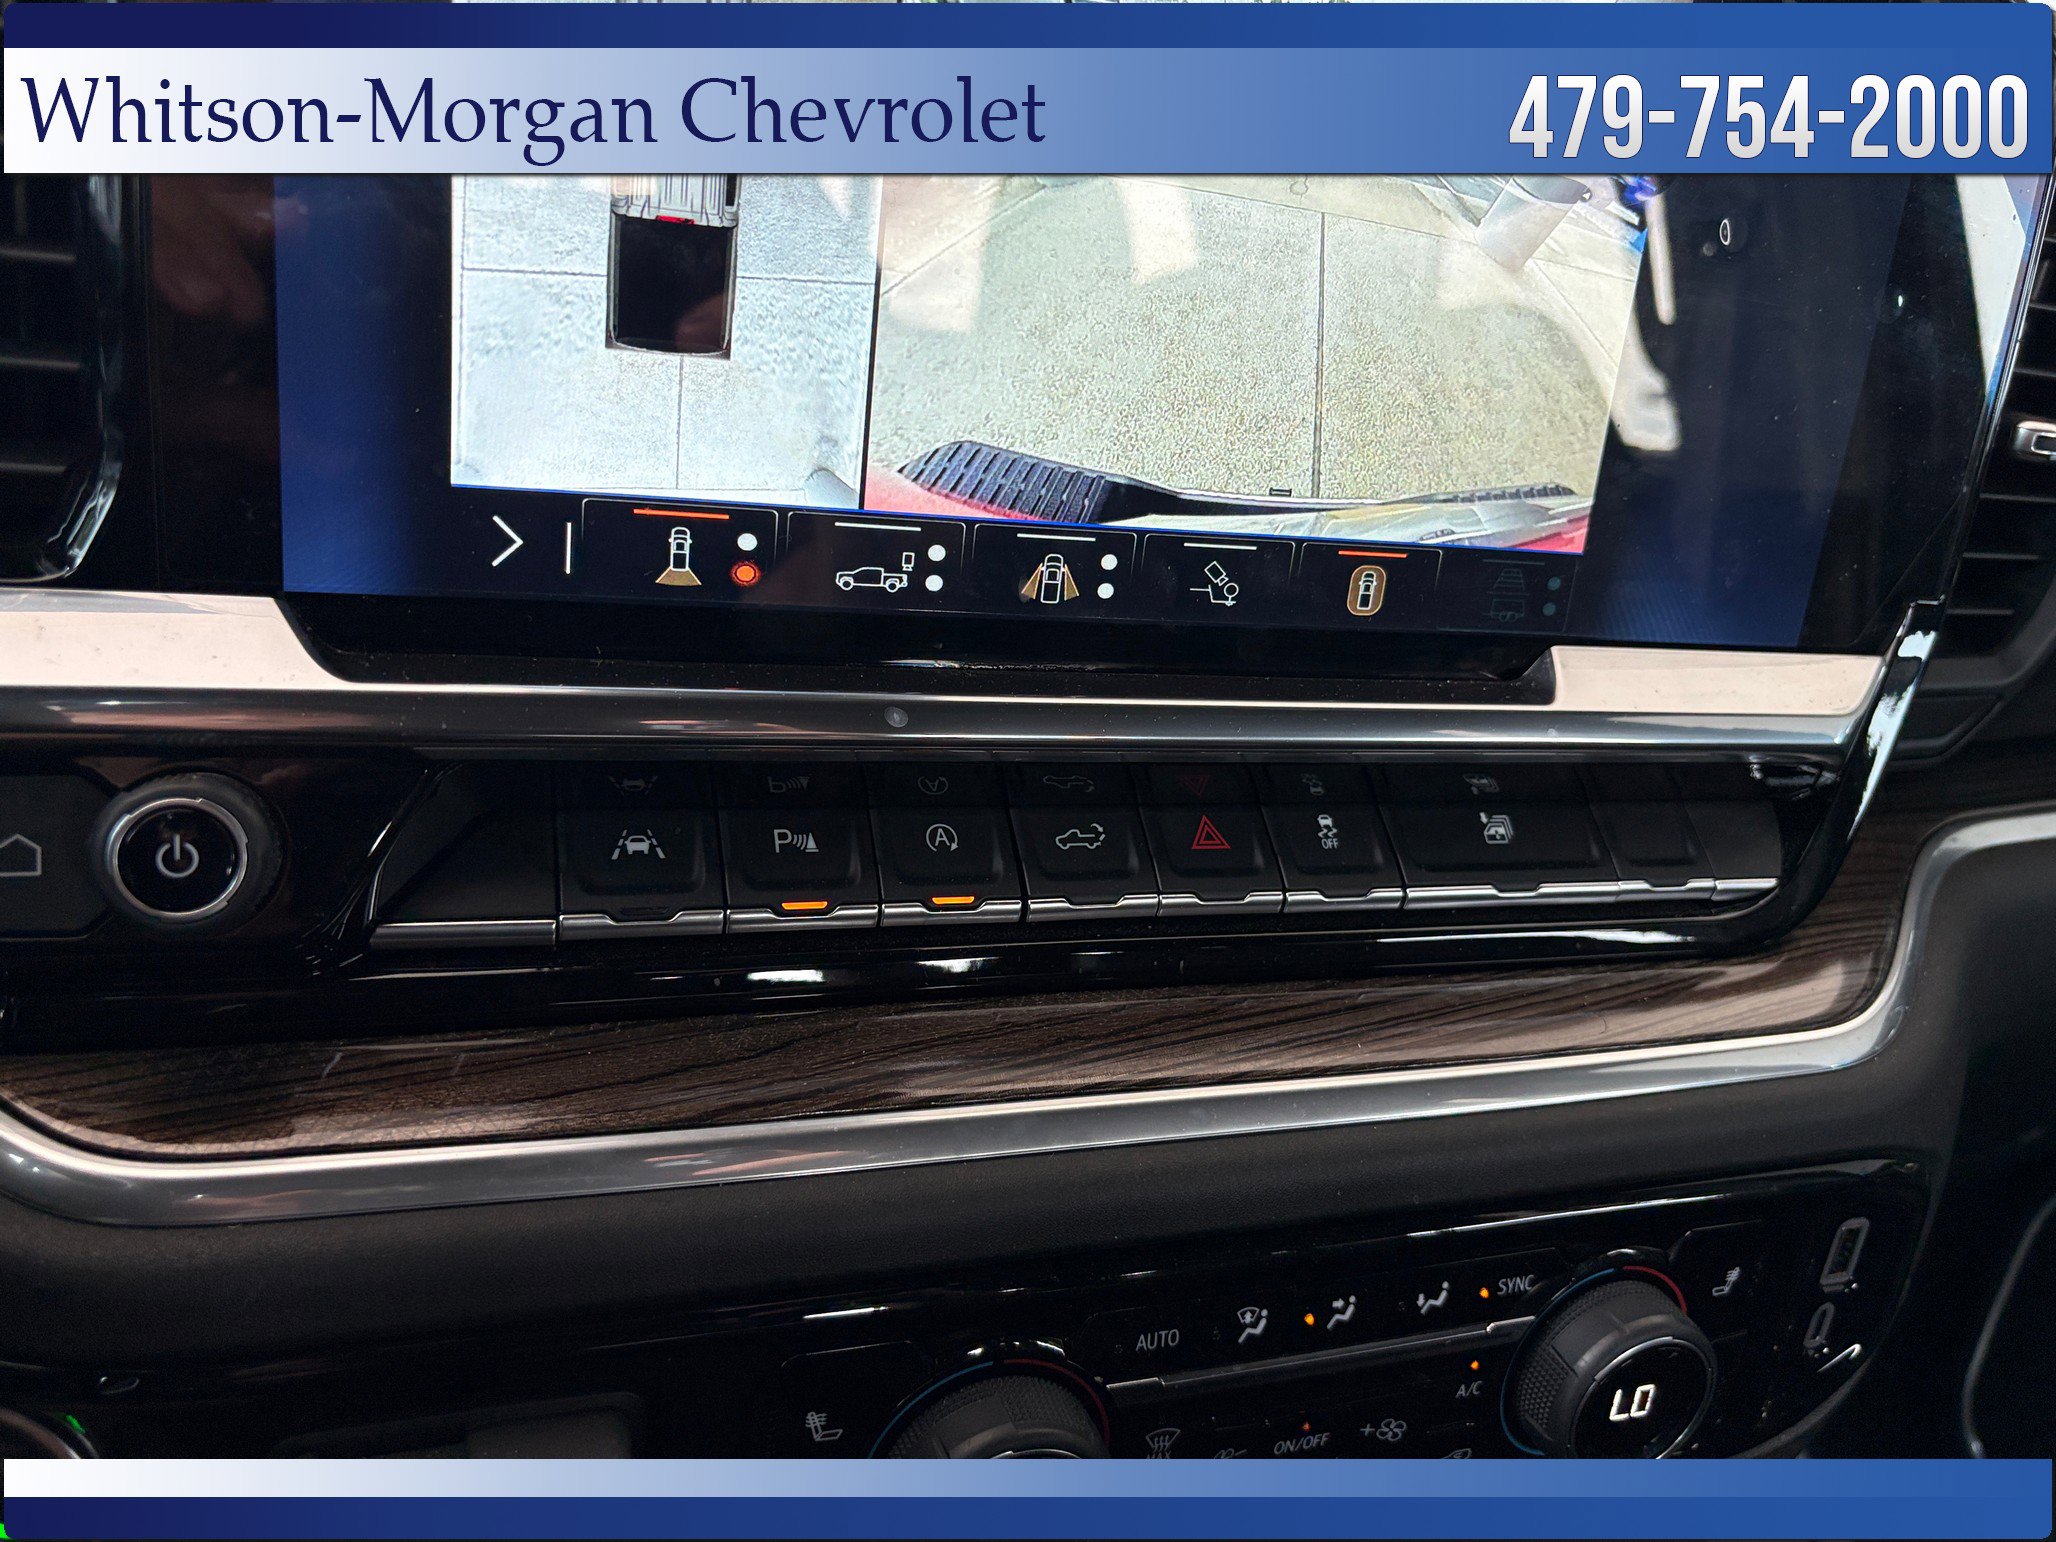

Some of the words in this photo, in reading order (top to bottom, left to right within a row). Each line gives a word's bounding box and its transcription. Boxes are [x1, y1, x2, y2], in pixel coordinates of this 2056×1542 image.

[1321, 838, 1339, 849] OFF
[1497, 1274, 1534, 1295] SYNC
[1135, 1328, 1180, 1351] AUTO
[1455, 1380, 1482, 1399] A/C
[1273, 1432, 1330, 1455] ON/OFF
